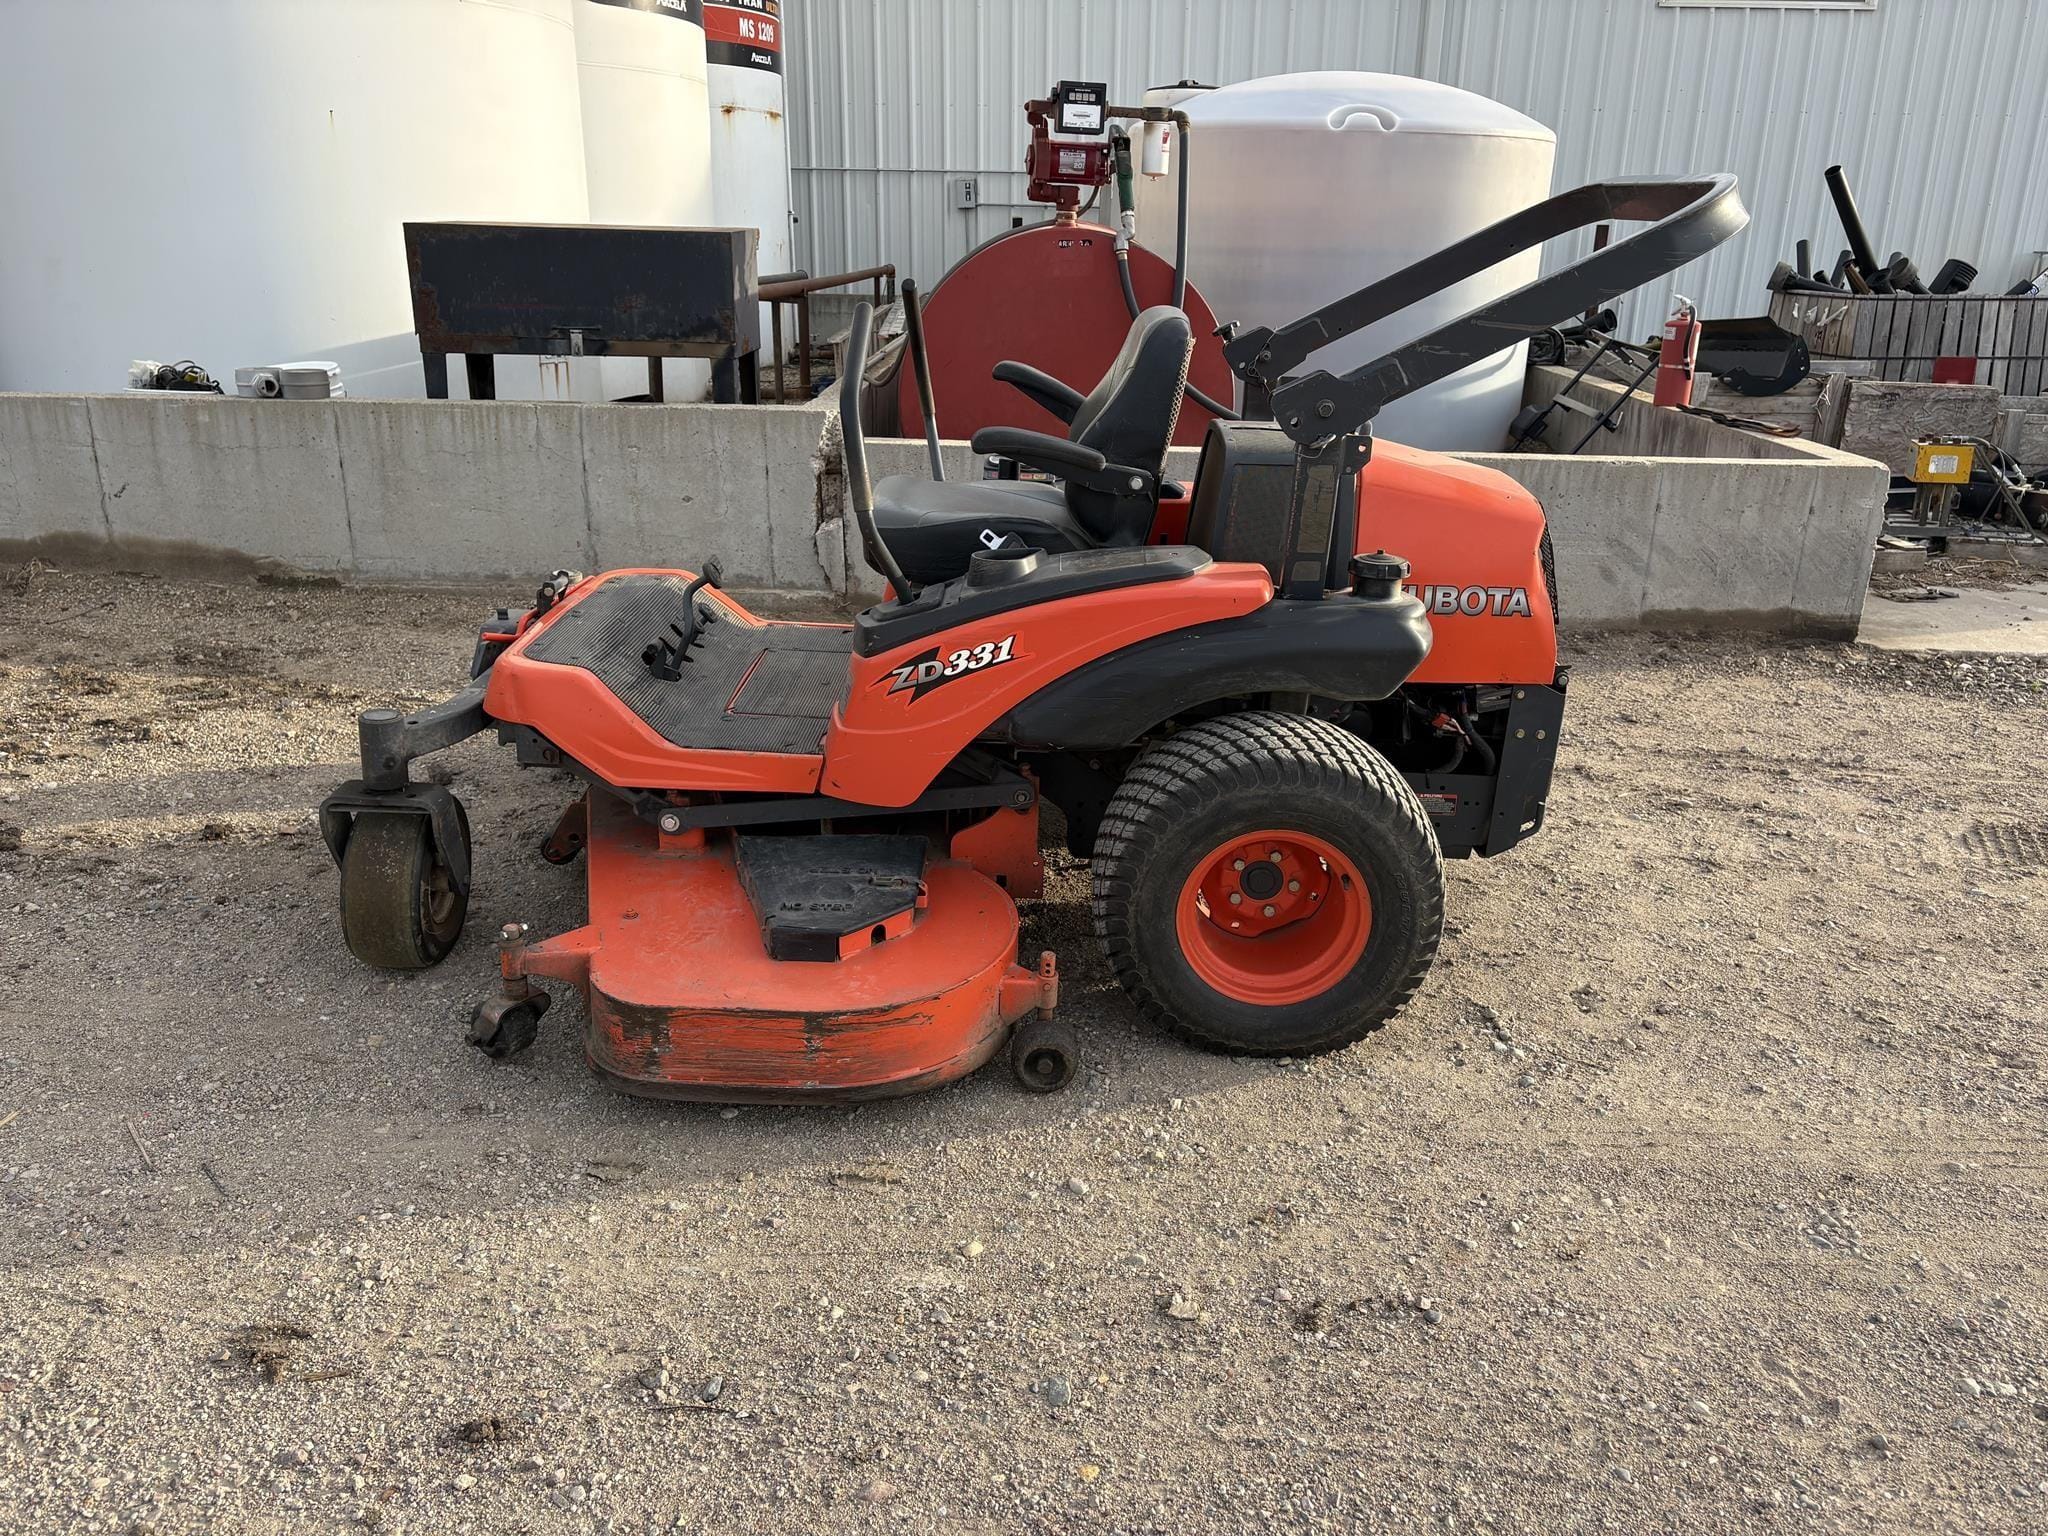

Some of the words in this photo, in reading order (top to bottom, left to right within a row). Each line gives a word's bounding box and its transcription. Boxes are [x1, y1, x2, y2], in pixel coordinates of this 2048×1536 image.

[739, 17, 755, 39] MS
[757, 20, 774, 43] 1209
[1401, 584, 1532, 616] UBOTA
[889, 635, 1015, 693] ZD331
